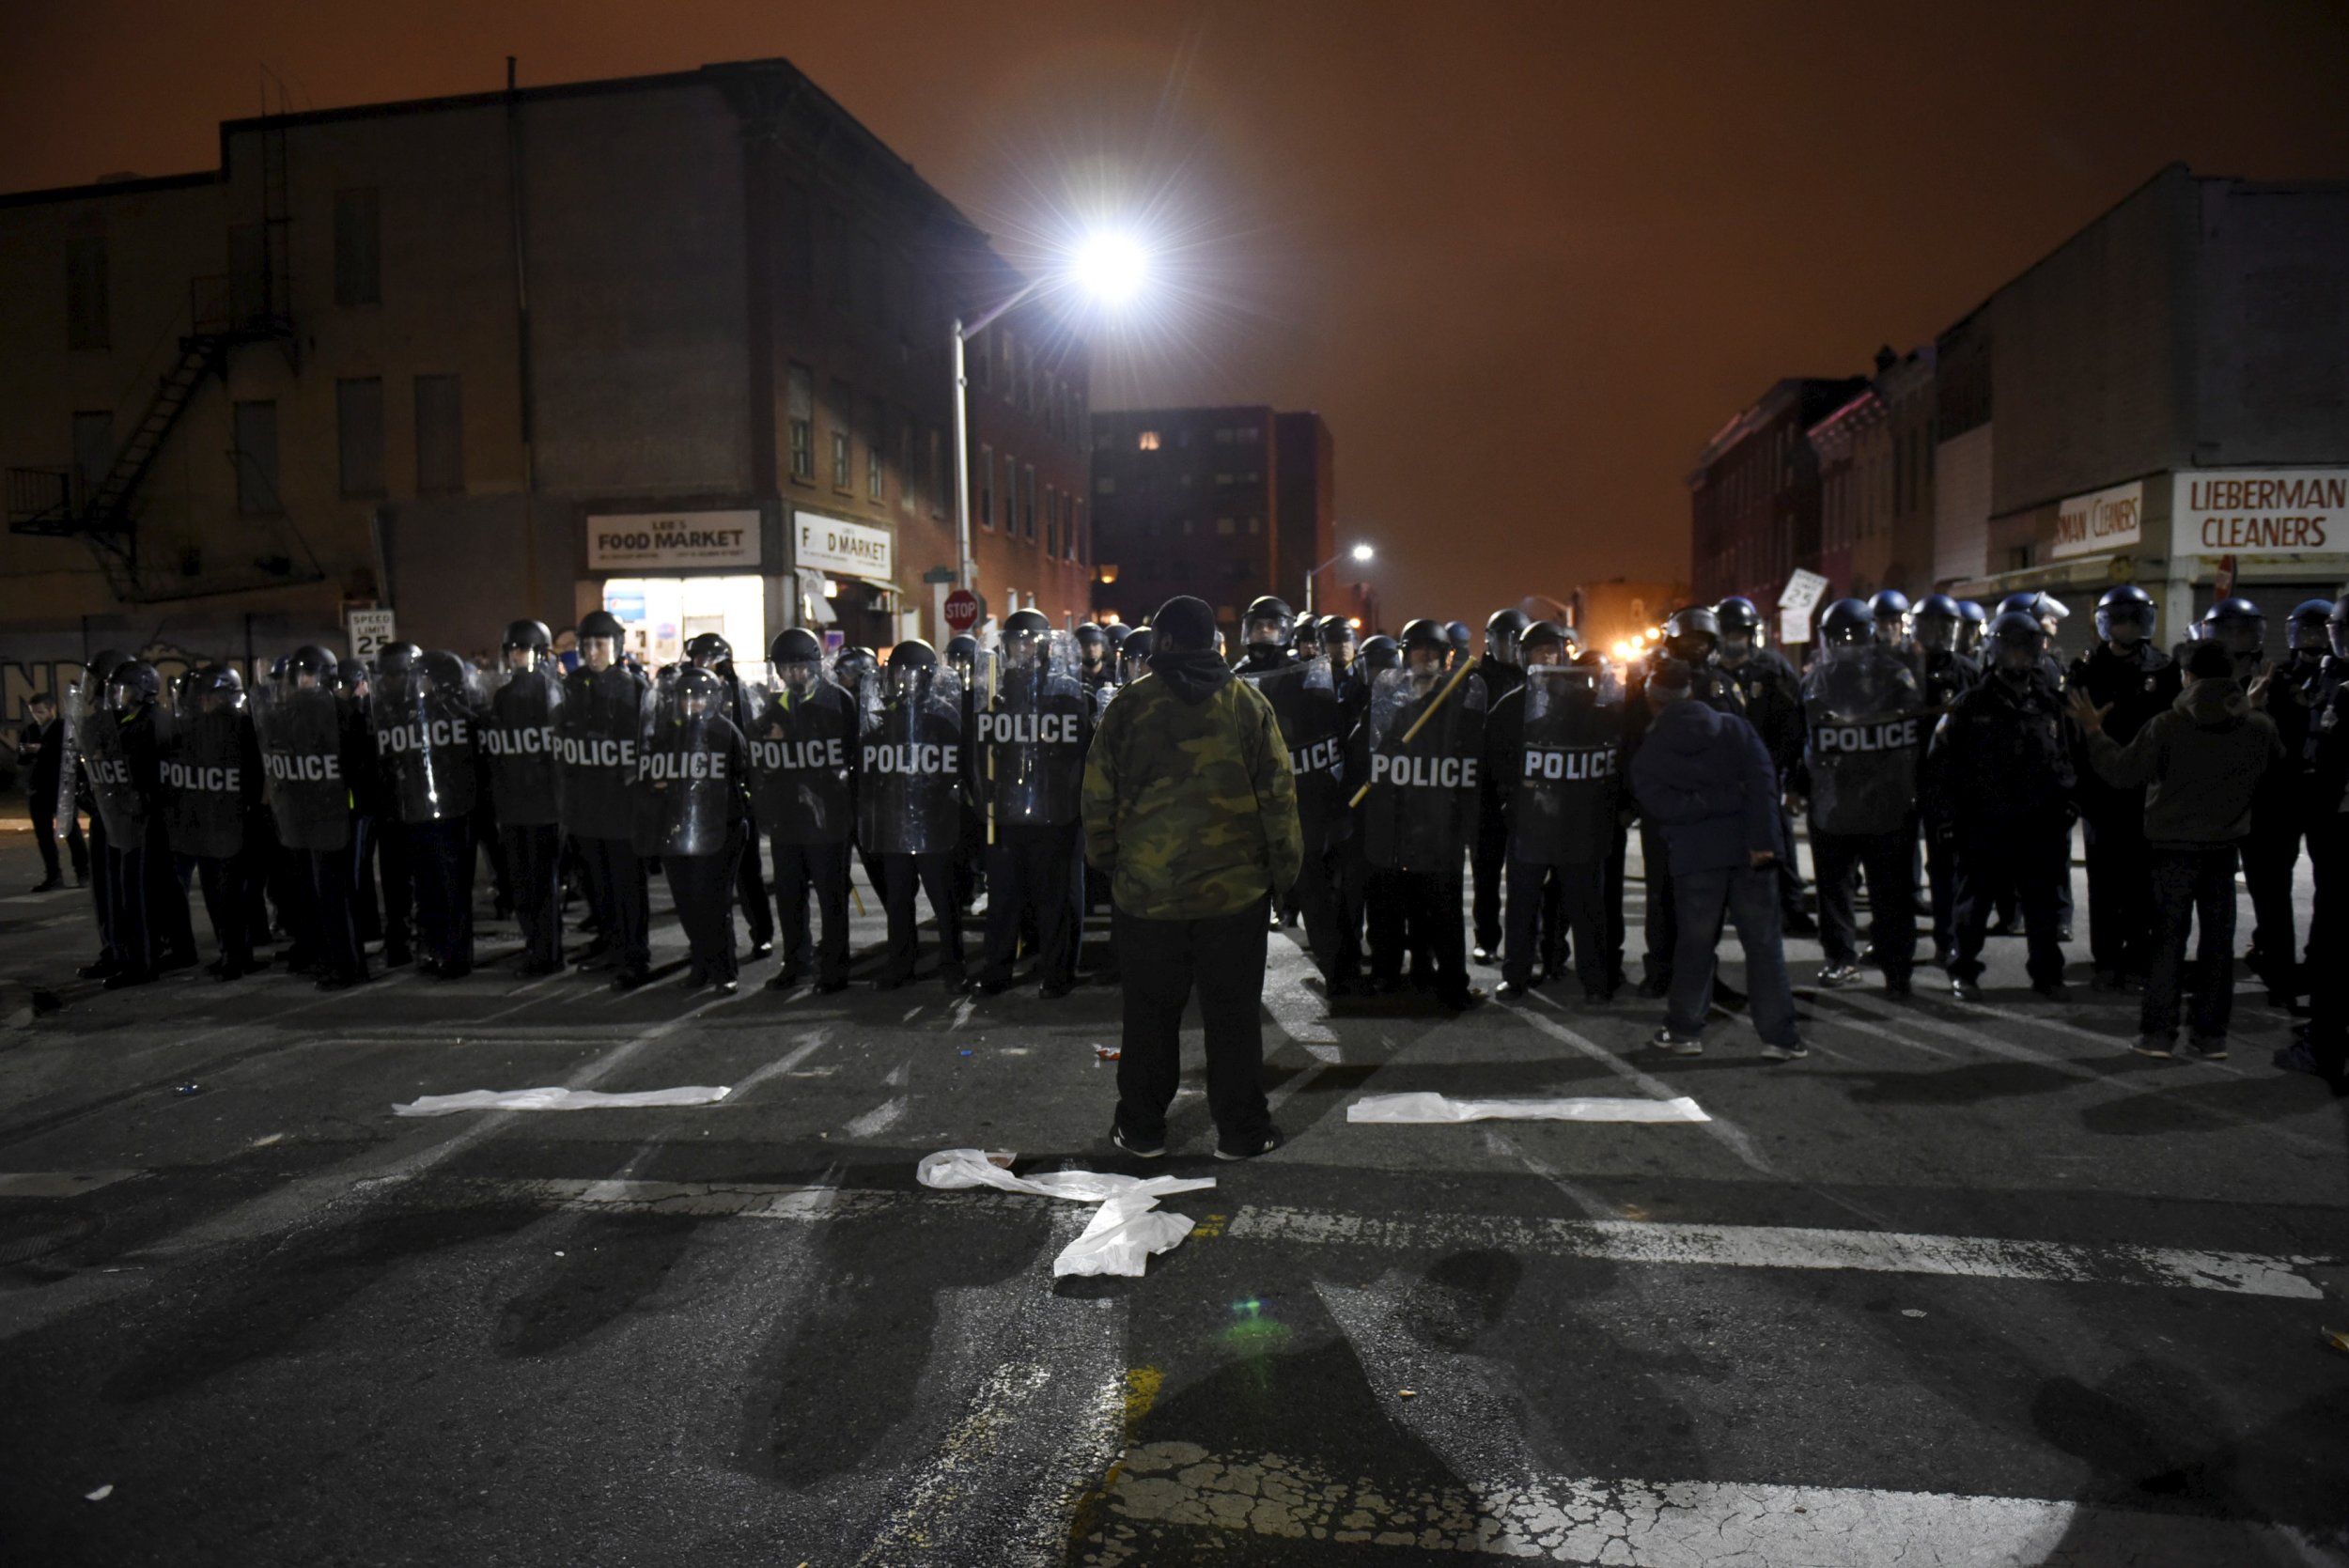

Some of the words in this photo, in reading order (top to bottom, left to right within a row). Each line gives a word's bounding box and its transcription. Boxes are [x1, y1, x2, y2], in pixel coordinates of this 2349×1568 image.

[2191, 479, 2346, 511] LIEBERMAN
[2092, 497, 2138, 537] CLEANERS
[598, 533, 650, 551] FOOD
[657, 530, 744, 550] MARKET
[2202, 517, 2326, 548] CLEANERS
[839, 536, 885, 562] MARKET
[353, 614, 390, 625] SPEED
[946, 602, 975, 619] STOP
[358, 626, 386, 635] LIMIT
[378, 719, 468, 755] POLICE
[477, 726, 554, 755] POLICE
[977, 714, 1078, 743] POLICE
[1818, 719, 1918, 752] POLICE
[263, 753, 340, 782] POLICE
[552, 739, 636, 767] POLICE
[638, 753, 725, 782] POLICE
[751, 738, 844, 769] POLICE
[863, 744, 957, 774] POLICE
[1289, 737, 1340, 775] LICE
[1524, 749, 1617, 780] POLICE
[91, 760, 129, 784] LICE
[159, 760, 241, 792] POLICE
[1371, 753, 1478, 787] POLICE
